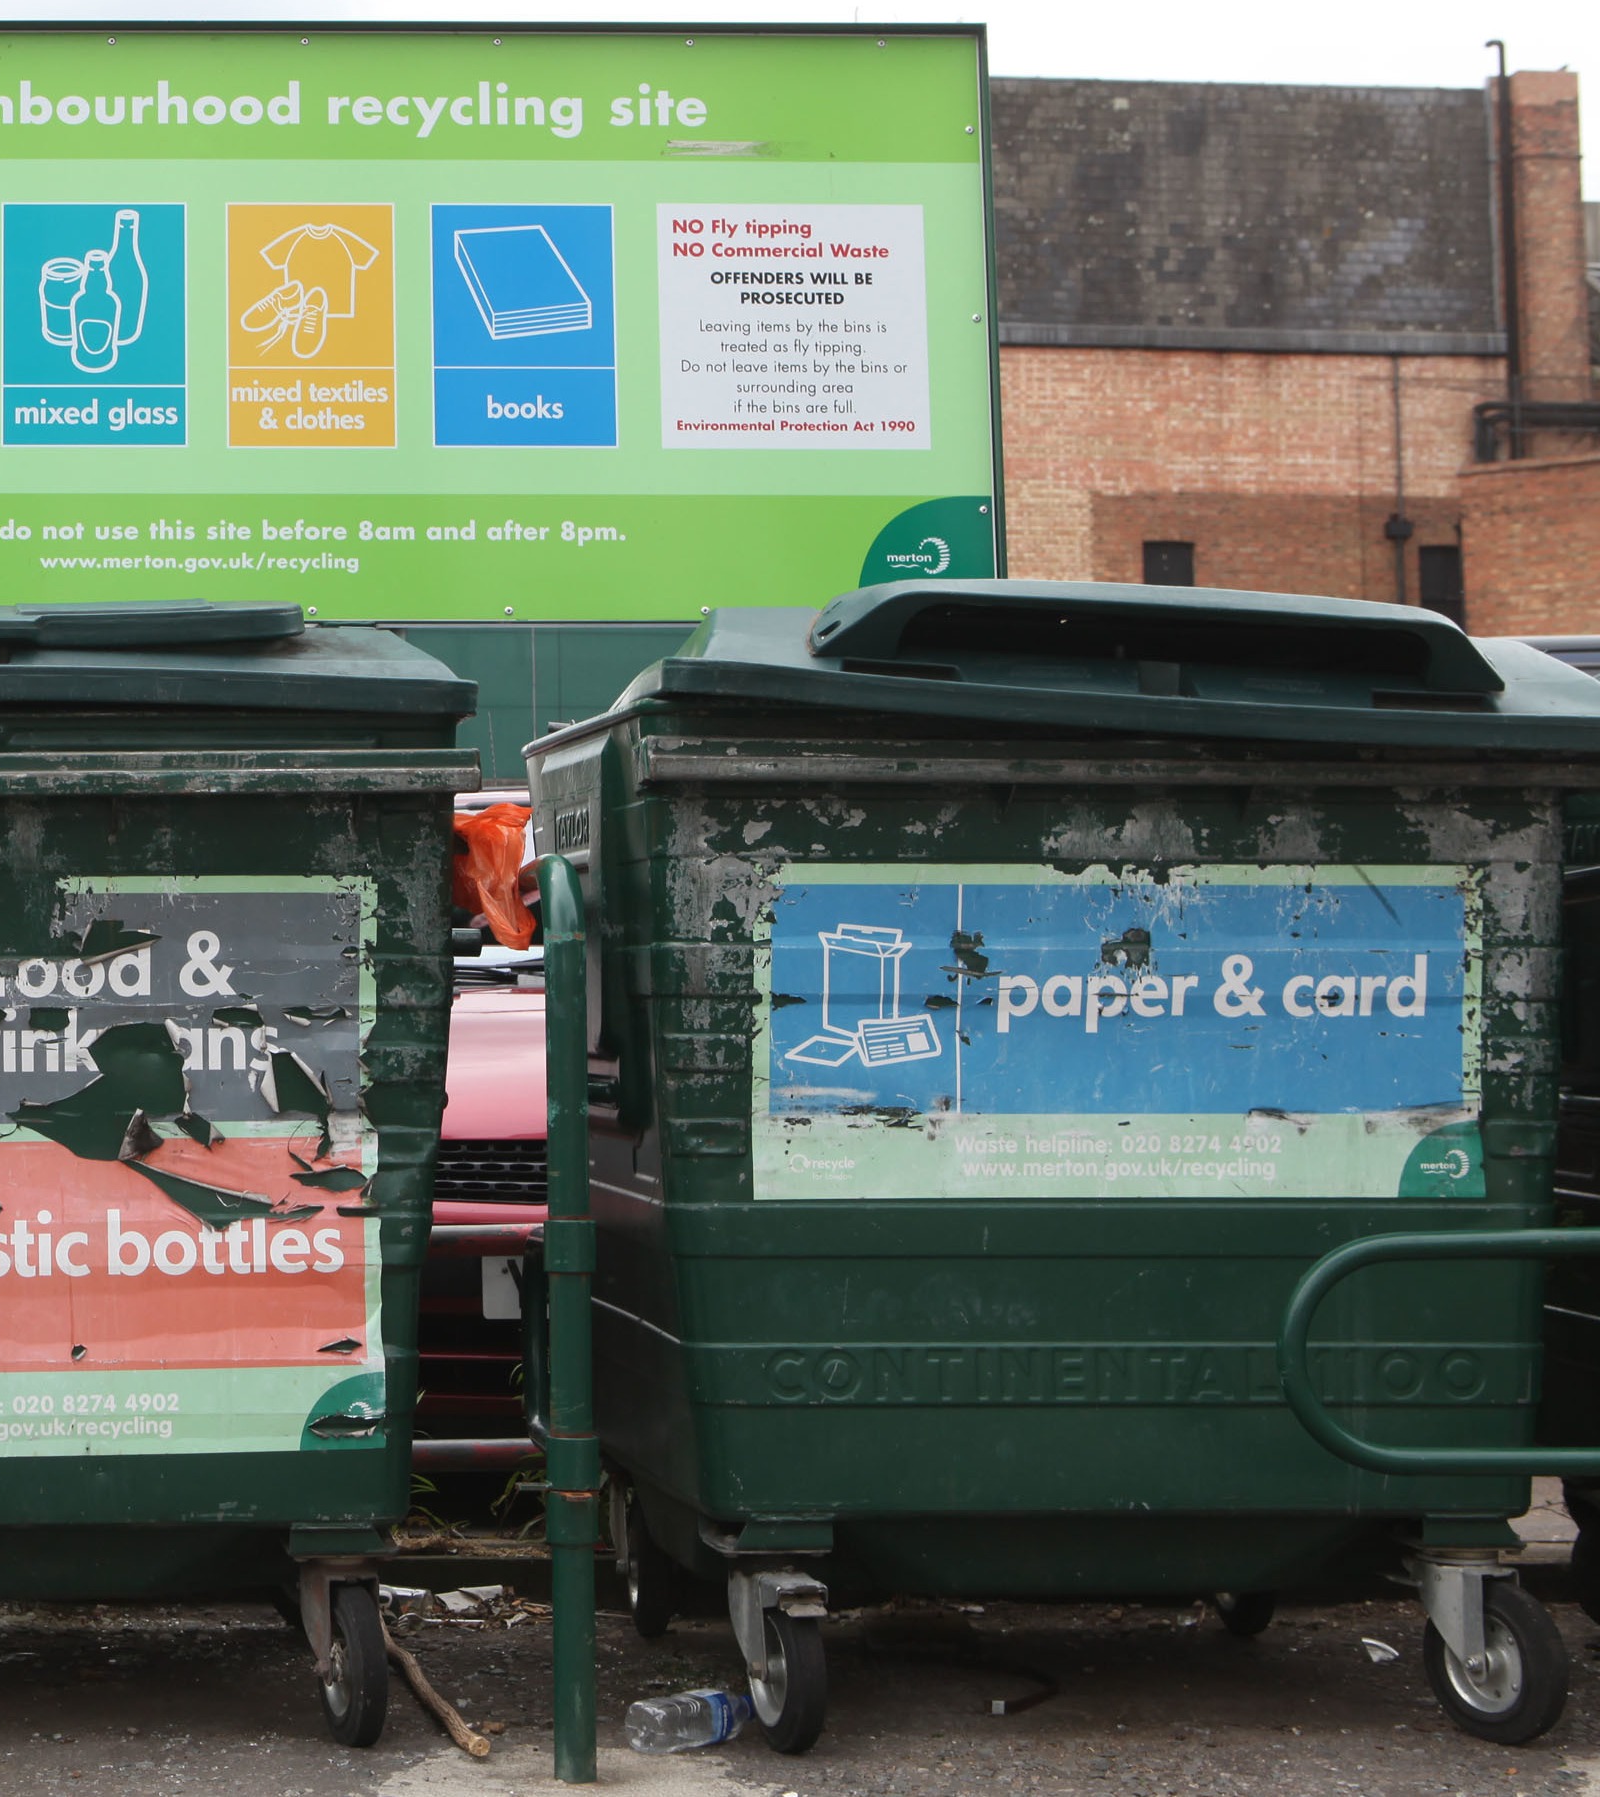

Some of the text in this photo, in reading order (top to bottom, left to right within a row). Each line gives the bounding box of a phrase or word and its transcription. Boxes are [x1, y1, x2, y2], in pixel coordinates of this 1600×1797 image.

[327, 80, 584, 139] recycling
[609, 83, 709, 128] site
[672, 218, 812, 239] NO Fly tipping
[672, 241, 889, 259] NO Commercial Waste
[710, 271, 873, 285] OFFENDERS WILL BE
[740, 291, 845, 305] PROSECUTED
[699, 318, 887, 337] Leaving items by the bins is
[720, 338, 867, 357] treated as fly tipping.
[681, 358, 908, 377] Do not leave items by the bins or
[231, 379, 390, 403] mixed textiles
[736, 379, 854, 398] surrounding area
[14, 397, 179, 432] mixed glass
[486, 394, 564, 420] books
[733, 398, 858, 414] if the bins are full.
[258, 406, 366, 431] & clothes
[676, 419, 916, 432] Environmental Protection Act 1990
[42, 522, 85, 541] not
[94, 525, 140, 541] use
[148, 518, 196, 541] this
[206, 519, 252, 541] site
[261, 518, 348, 541] before
[358, 520, 416, 541] 8am
[425, 519, 477, 541] and
[486, 519, 551, 542] after
[560, 520, 627, 547] 8pm.
[39, 551, 360, 574] www.merton.gov.uk/recycling
[886, 553, 932, 566] merton
[179, 930, 238, 998] &
[996, 953, 1429, 1034] paper & card
[177, 1024, 280, 1073] ans
[955, 1134, 1282, 1158] Waste helpline: 020 8274 4902
[811, 1155, 856, 1171] recycle
[963, 1156, 1277, 1181] www.merton.gov.uk/recycling
[1420, 1162, 1457, 1170] merton
[107, 1208, 346, 1277] bottles
[765, 1348, 1278, 1402] CONTINENTAL
[12, 1395, 55, 1414] 020
[62, 1394, 117, 1414] 8274
[124, 1393, 180, 1412] 4902
